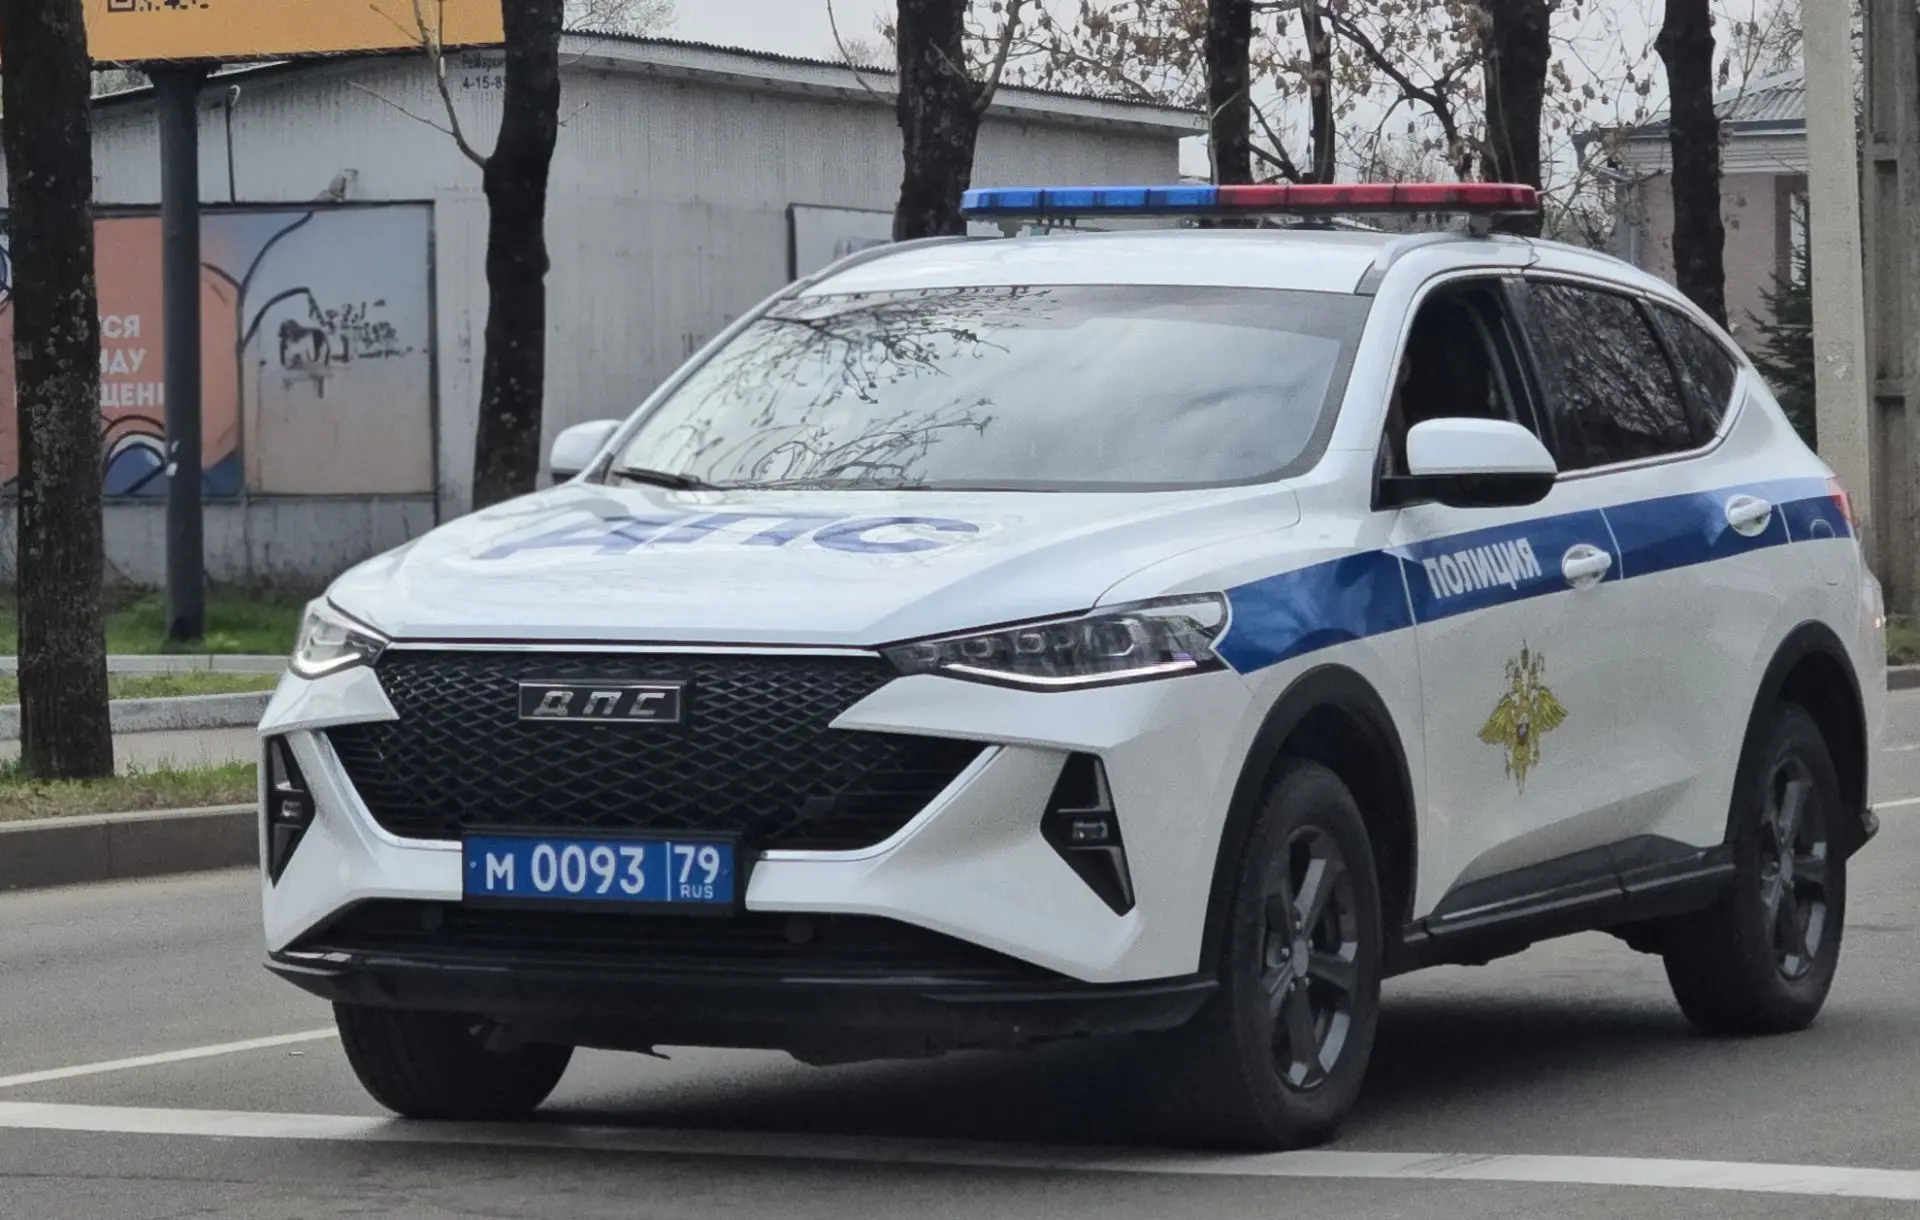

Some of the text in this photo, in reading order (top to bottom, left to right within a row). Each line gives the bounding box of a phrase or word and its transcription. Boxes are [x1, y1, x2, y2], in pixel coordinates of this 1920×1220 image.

[463, 75, 506, 90] 4-15-8
[99, 314, 140, 339] СЯ
[1422, 537, 1542, 599] ПОЛИЦИЯ
[533, 690, 666, 716] ДПС
[531, 843, 645, 895] 0093
[674, 846, 720, 885] 79
[680, 884, 714, 899] RUS
